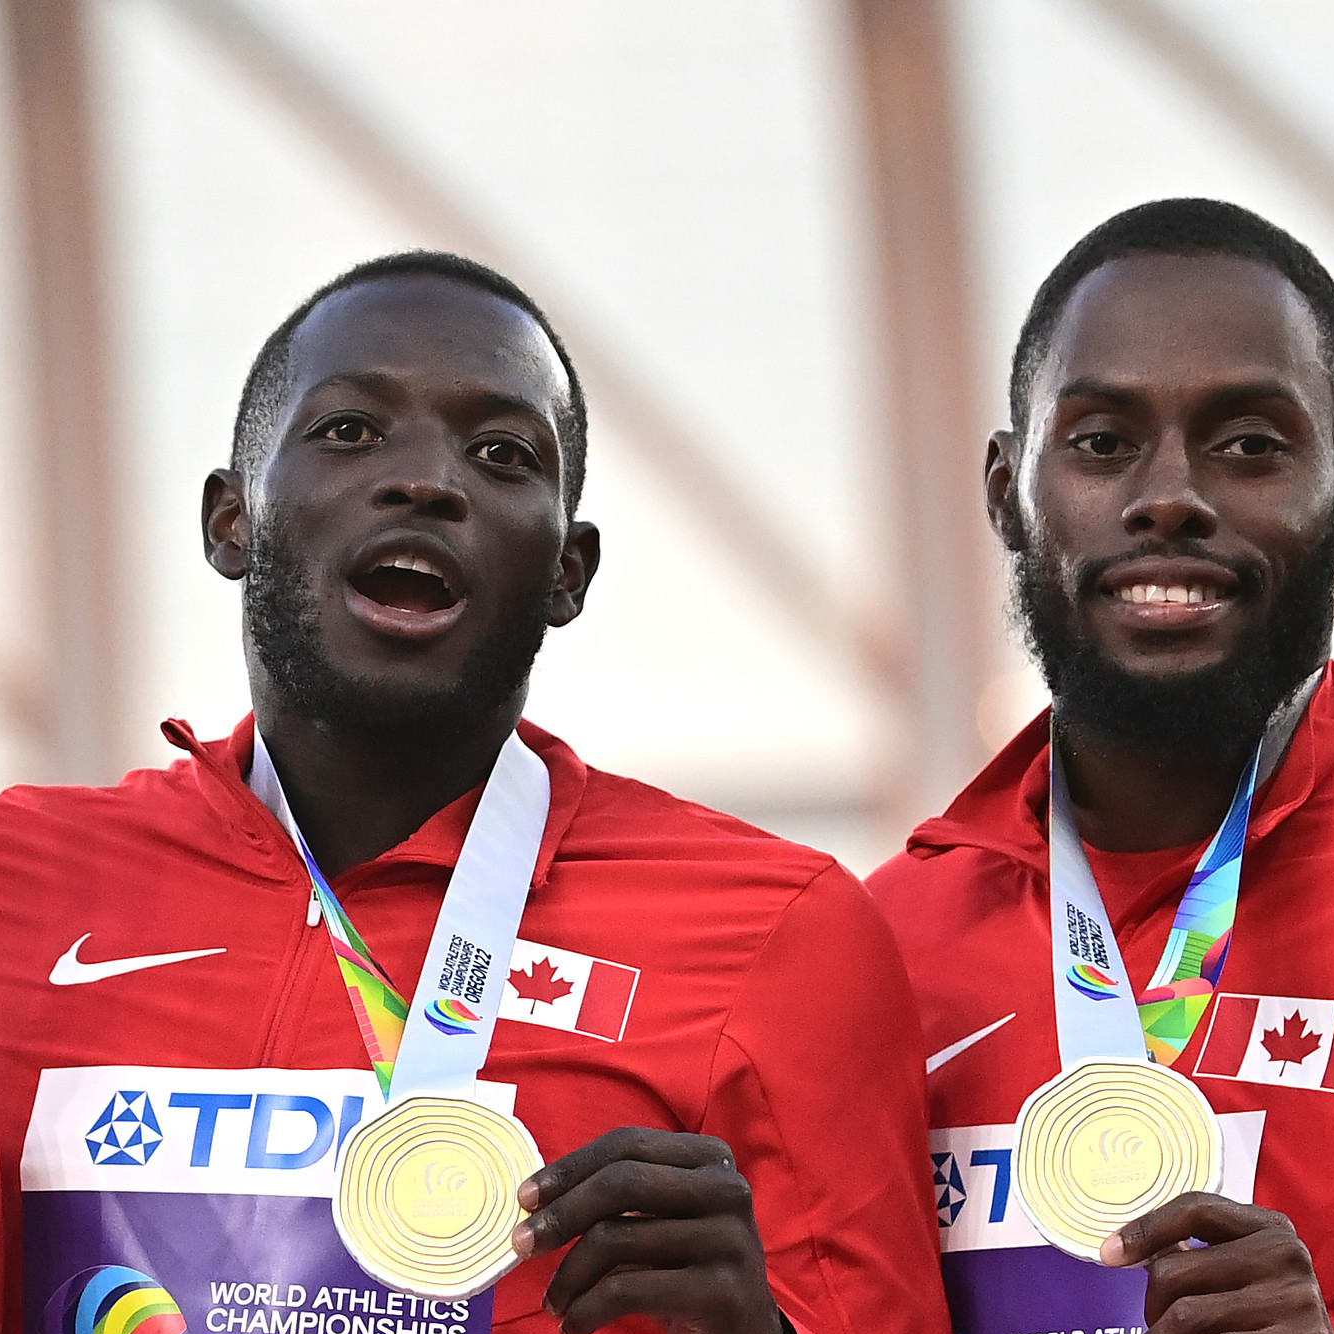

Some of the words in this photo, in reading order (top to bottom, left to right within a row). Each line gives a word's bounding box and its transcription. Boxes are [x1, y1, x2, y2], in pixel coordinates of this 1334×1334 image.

[464, 948, 492, 1004] OREGON22
[210, 1281, 307, 1308] WORLD
[312, 1286, 470, 1322] ATHLETICS
